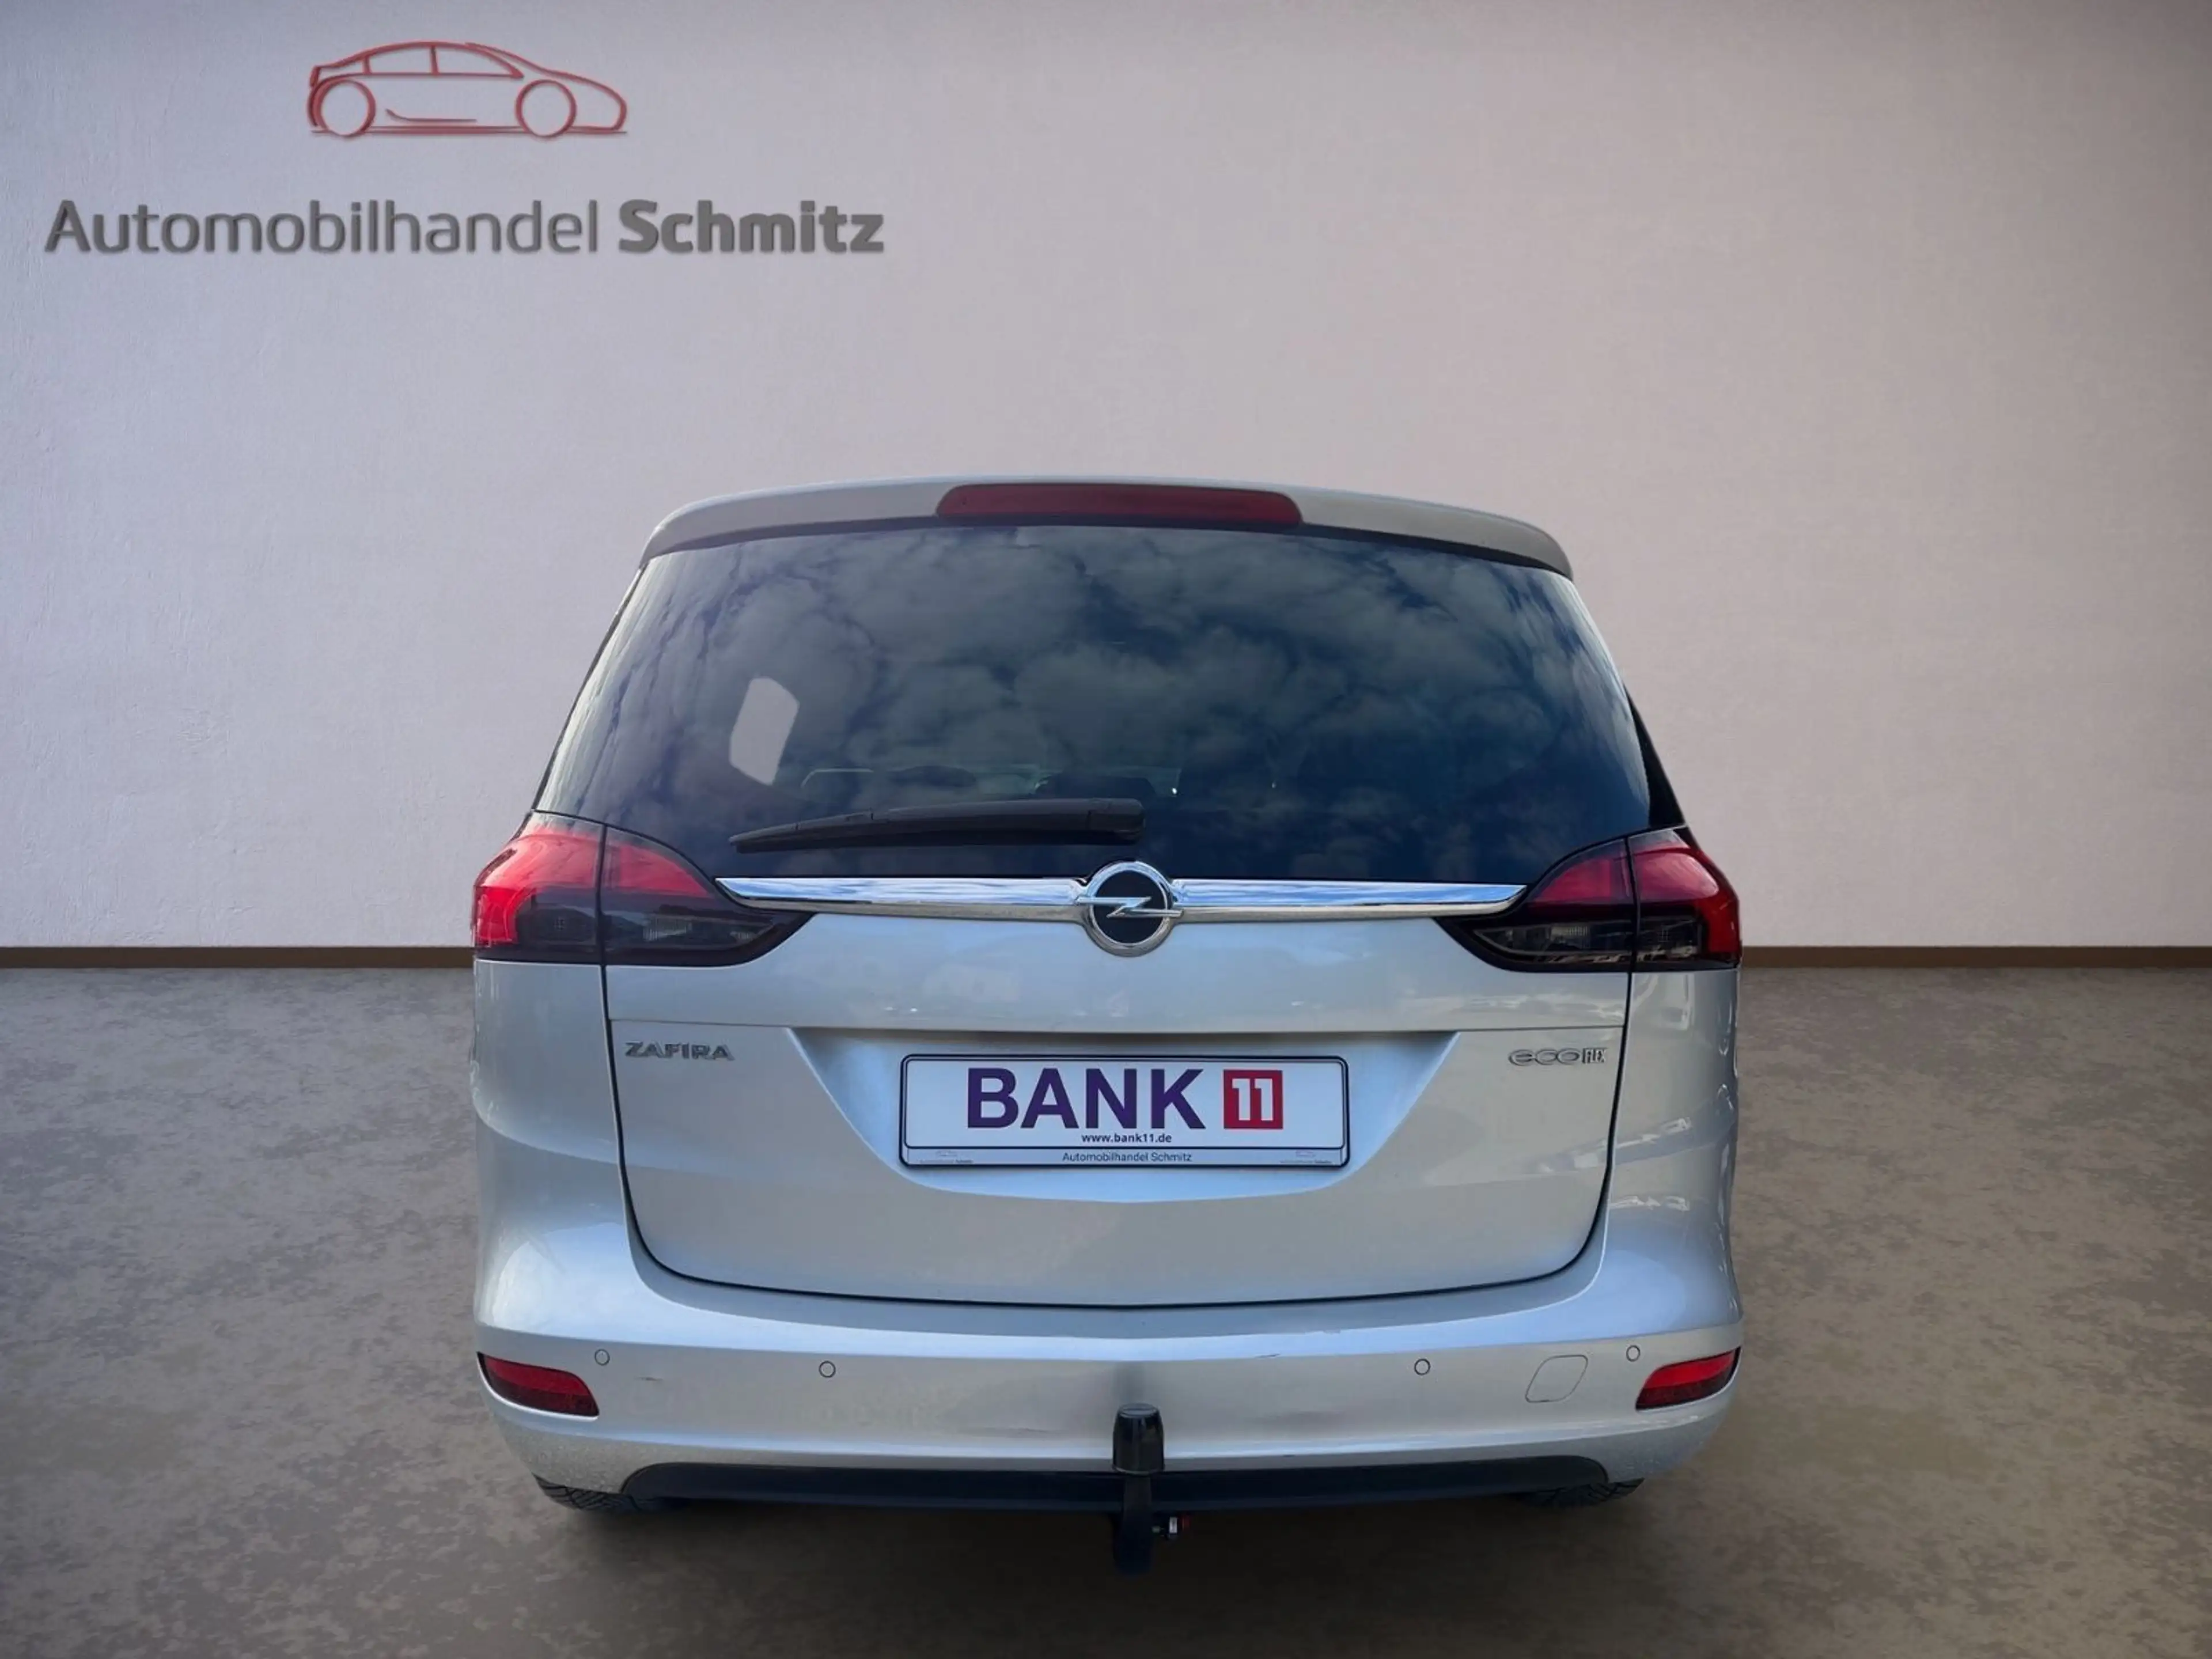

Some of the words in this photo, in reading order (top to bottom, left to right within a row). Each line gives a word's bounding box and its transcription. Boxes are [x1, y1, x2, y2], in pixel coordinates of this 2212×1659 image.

[44, 199, 598, 253] Automobilhandel
[618, 199, 884, 253] Schmitz
[625, 1041, 735, 1061] ZAFIRA
[967, 1067, 1206, 1128] BANK
[1232, 1078, 1273, 1120] 11
[1081, 1132, 1172, 1143] www.bank11.de
[1062, 1152, 1148, 1162] Automobilhandel
[1151, 1152, 1192, 1162] Schmitz
